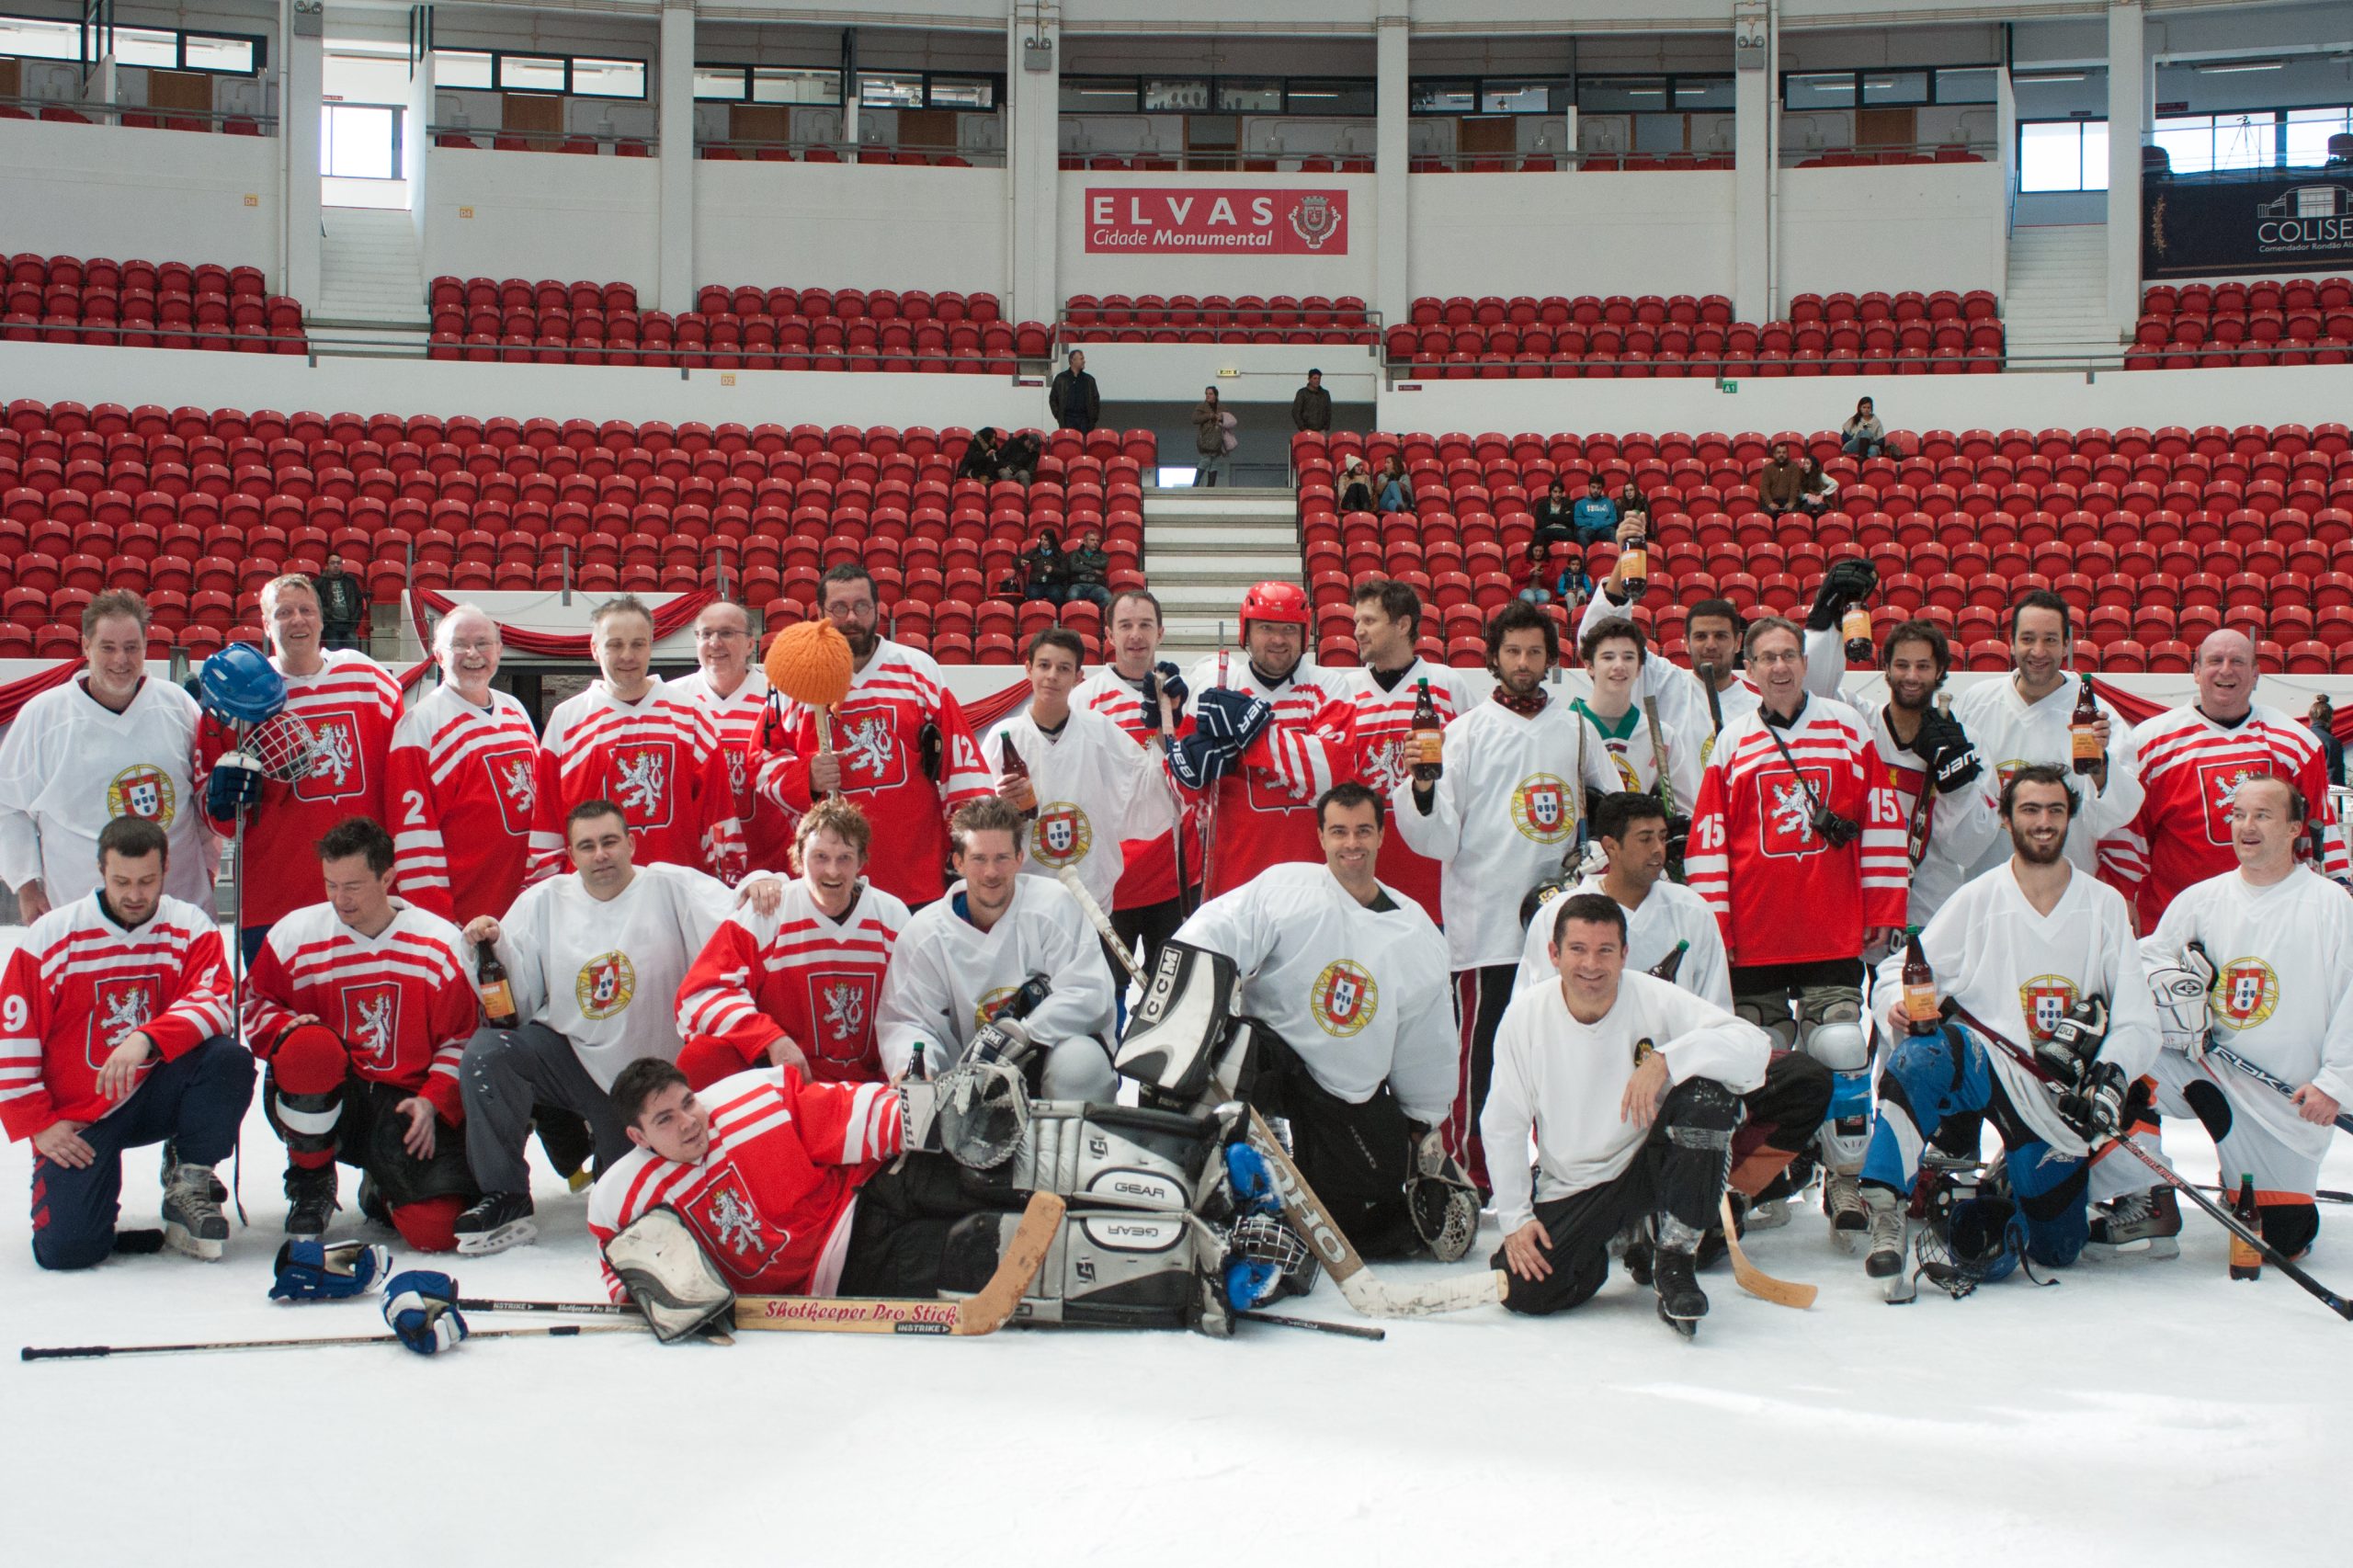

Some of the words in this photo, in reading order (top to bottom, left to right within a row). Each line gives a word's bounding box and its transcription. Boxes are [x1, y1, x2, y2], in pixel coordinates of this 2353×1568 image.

[1093, 197, 1274, 226] ELVAS
[1093, 230, 1147, 245] Cidade
[1153, 230, 1273, 246] Monumental
[2258, 219, 2353, 243] COLISE
[1724, 384, 1736, 392] A1
[952, 733, 980, 767] 12
[402, 790, 426, 825] 2
[1868, 787, 1898, 823] 15
[1697, 812, 1726, 849] 15
[1146, 948, 1182, 1017] CCM
[3, 994, 28, 1033] 9
[900, 1086, 915, 1147] ITECH
[1115, 1182, 1165, 1199] GEAR
[1108, 1225, 1159, 1237] GEAR
[764, 1301, 867, 1324] Shotkeeper
[872, 1303, 905, 1322] Pro
[911, 1304, 957, 1325] Stick
[897, 1324, 942, 1333] INSTRIKE
